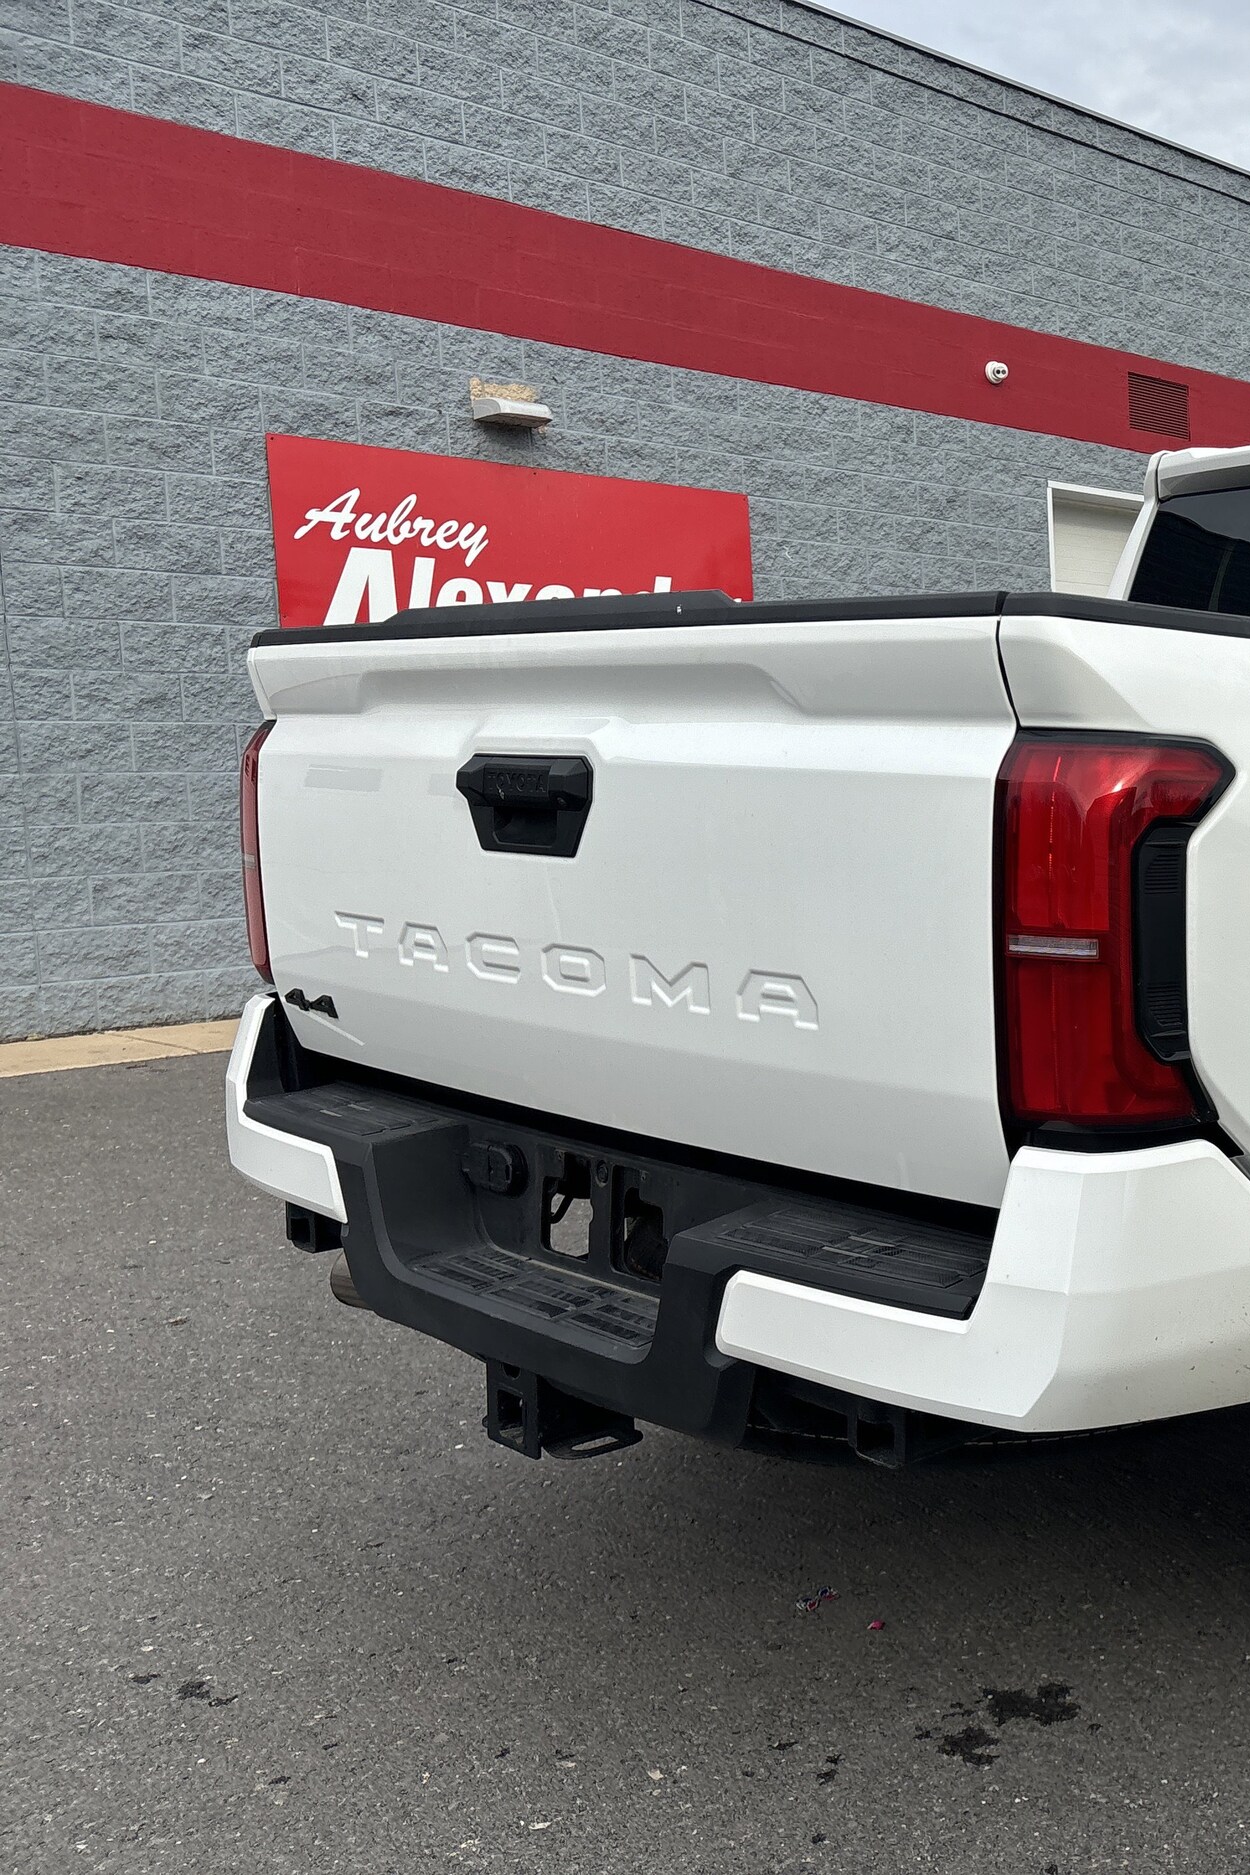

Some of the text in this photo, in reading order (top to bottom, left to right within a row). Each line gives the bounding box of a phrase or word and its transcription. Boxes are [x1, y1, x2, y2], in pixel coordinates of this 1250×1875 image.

[293, 487, 489, 567] Aubrey
[486, 771, 547, 794] TOYOTA
[334, 910, 819, 1030] TACOMA
